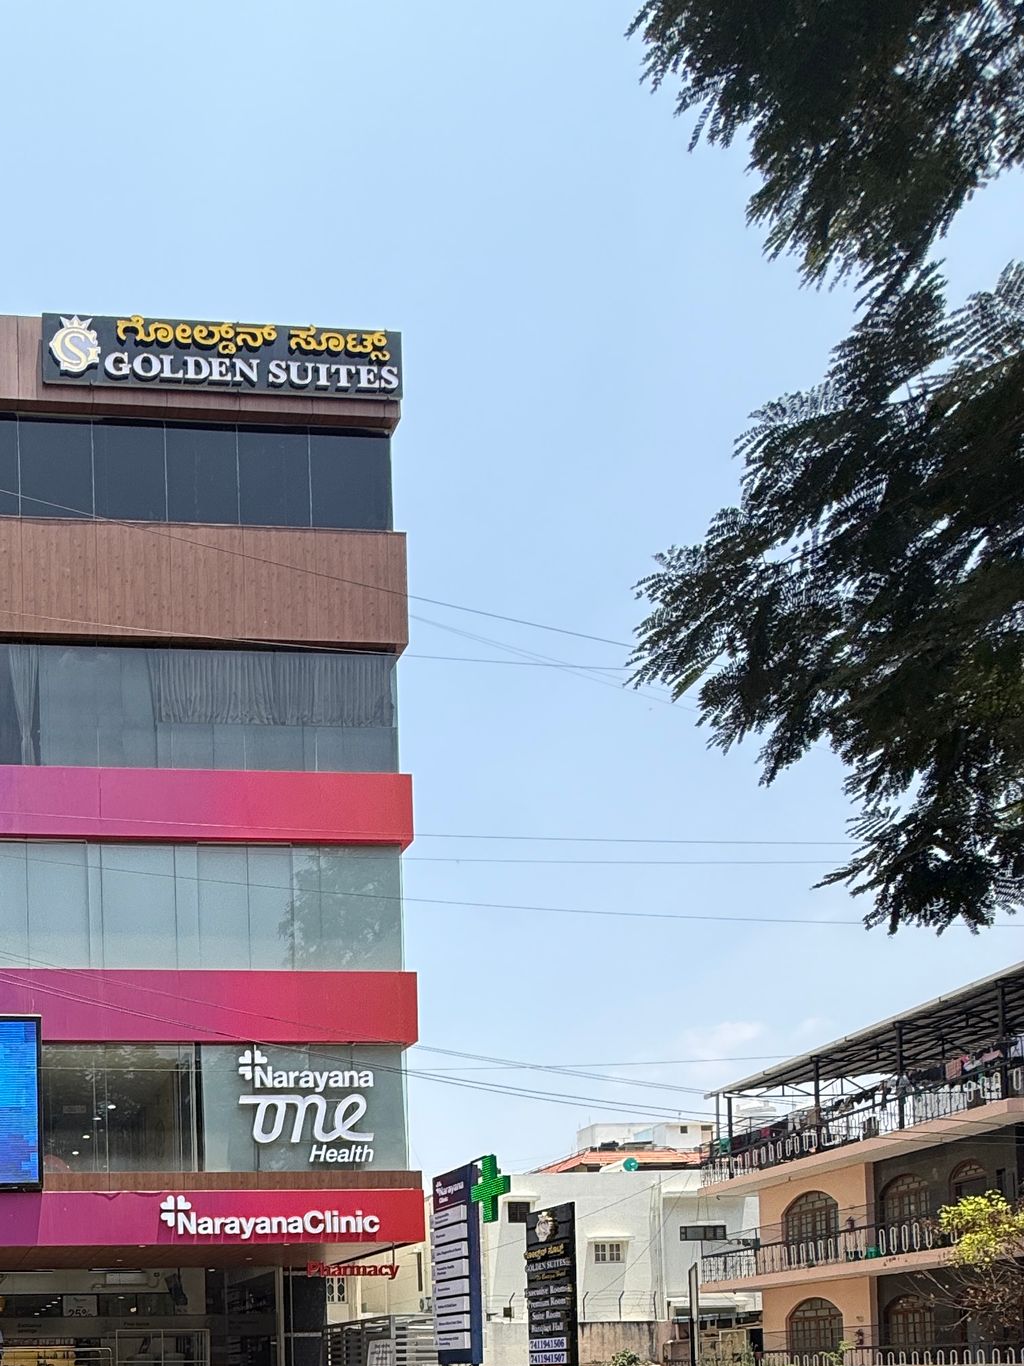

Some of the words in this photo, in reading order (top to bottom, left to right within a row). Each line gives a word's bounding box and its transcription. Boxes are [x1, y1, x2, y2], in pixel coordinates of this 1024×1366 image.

[104, 352, 260, 382] GOLDEN
[268, 360, 399, 389] SUITES
[254, 1066, 374, 1093] Narayana
[309, 1144, 374, 1162] Health
[307, 1261, 399, 1279] Pharmacy
